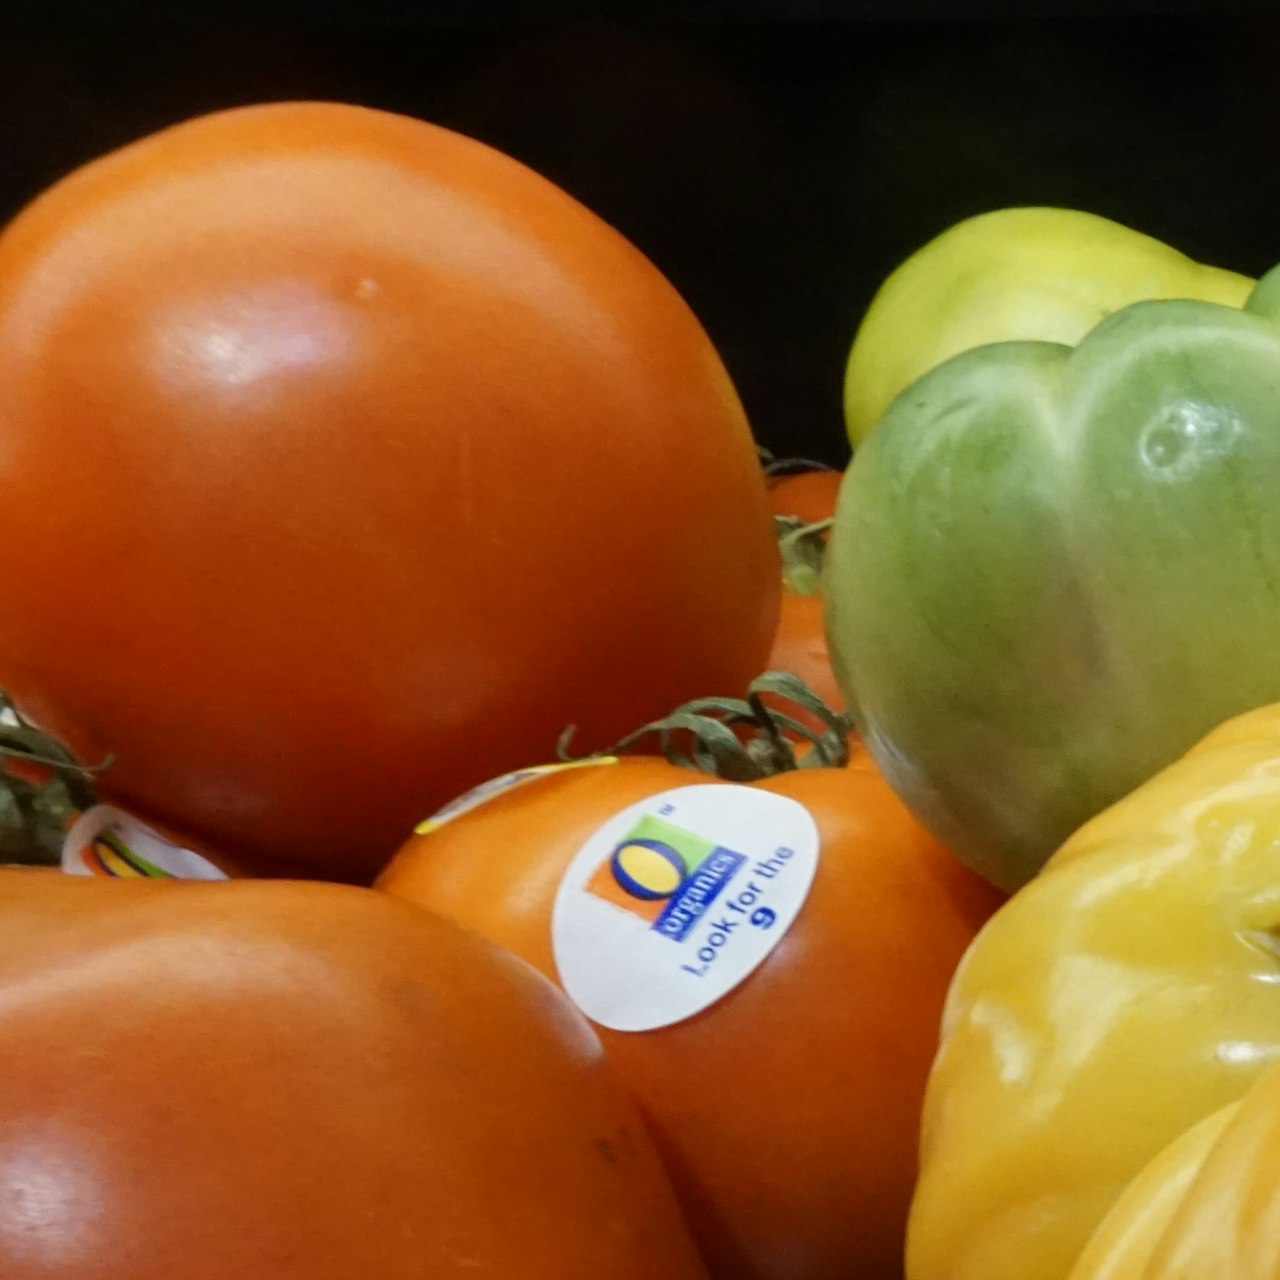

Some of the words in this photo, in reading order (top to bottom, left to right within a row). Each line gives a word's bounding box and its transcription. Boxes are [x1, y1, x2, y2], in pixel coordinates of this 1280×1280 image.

[662, 852, 736, 936] organics
[681, 917, 738, 978] Look
[726, 880, 764, 915] for
[754, 846, 794, 880] the
[750, 906, 777, 930] 9
